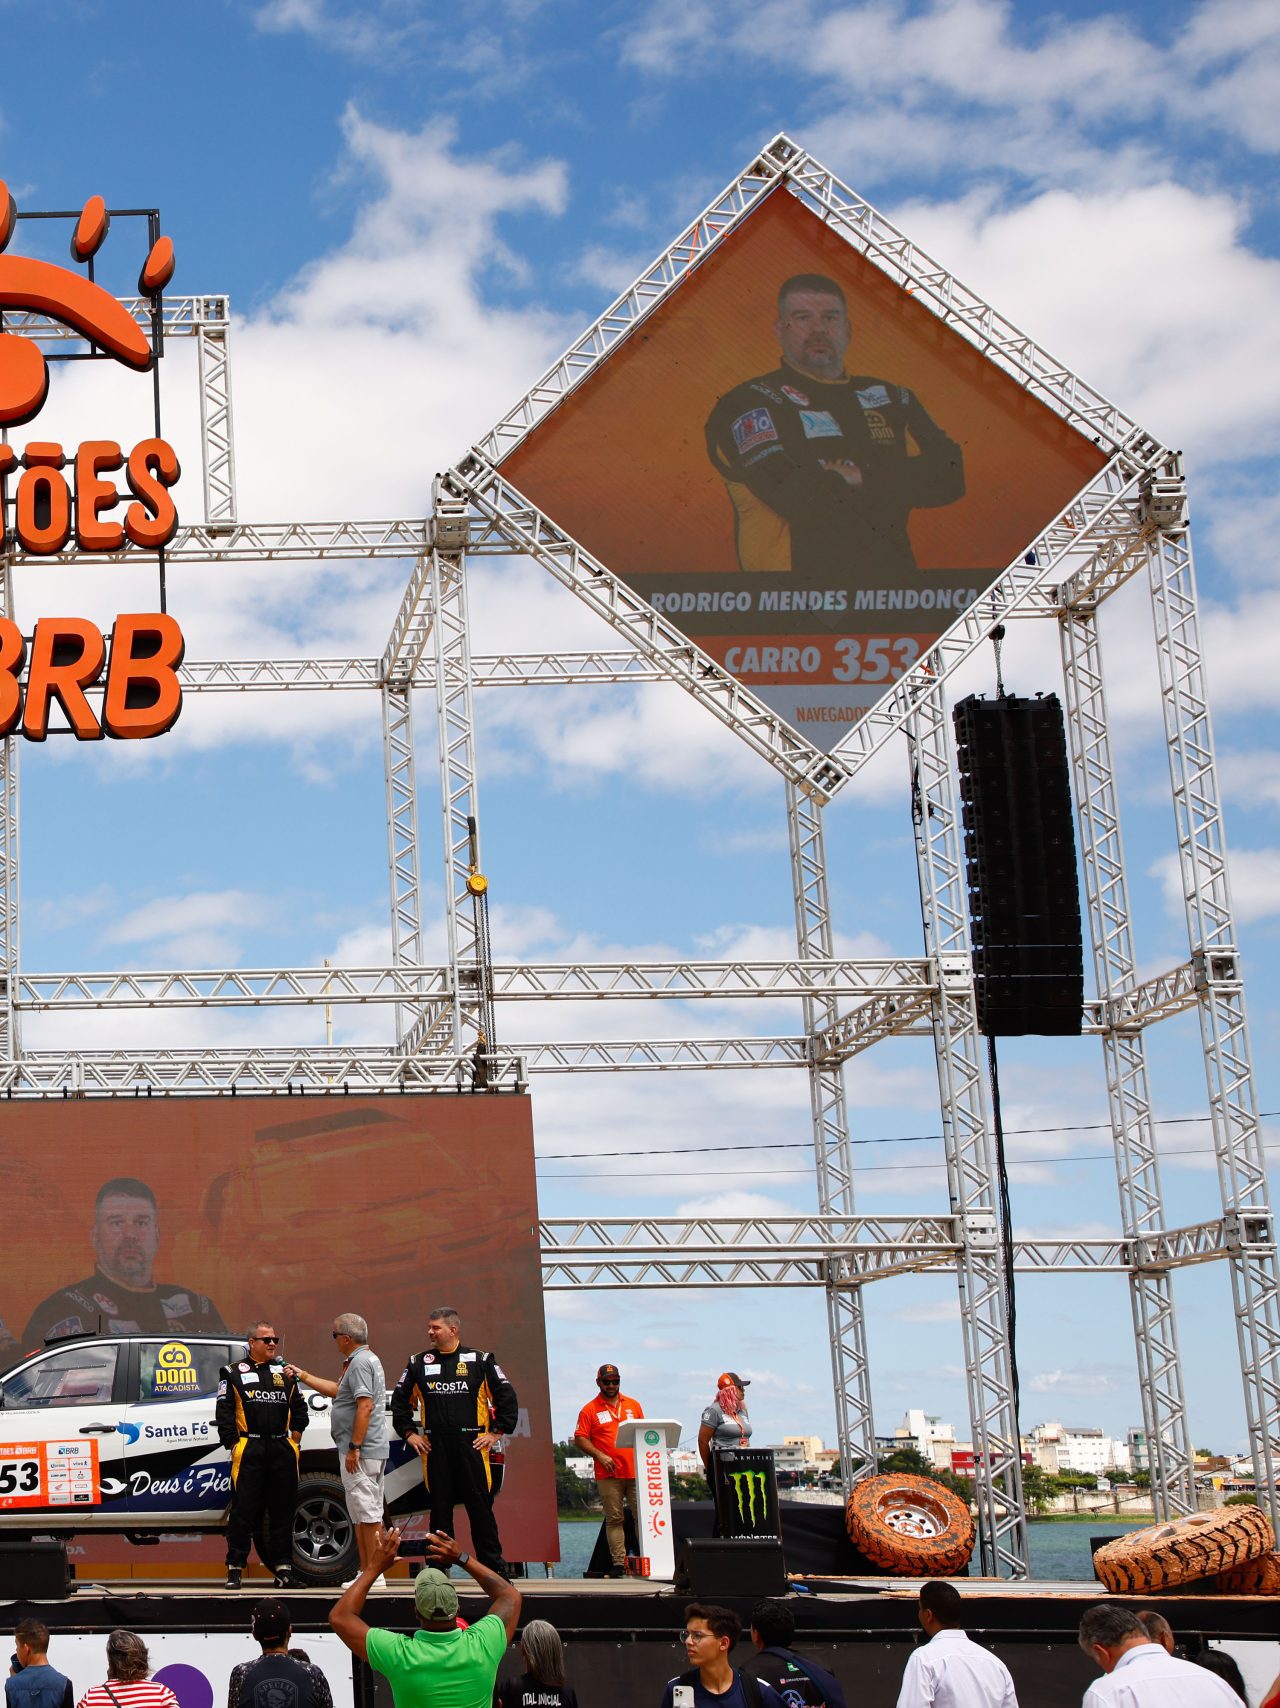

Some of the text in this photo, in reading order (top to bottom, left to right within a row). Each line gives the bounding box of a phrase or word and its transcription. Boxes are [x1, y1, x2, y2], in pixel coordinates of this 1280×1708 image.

[651, 588, 978, 615] RODRIGO MENDES MENDONÇA
[725, 637, 919, 682] CARRO 353
[156, 1369, 197, 1384] DOM
[154, 1384, 200, 1392] ATACADISTA
[145, 1422, 208, 1438] Santa Fé
[65, 1447, 79, 1455] BRB
[130, 1470, 181, 1497] Deus
[183, 1469, 195, 1493] é
[257, 1681, 295, 1694] SPECIAL
[538, 1692, 561, 1707] INICIAL
